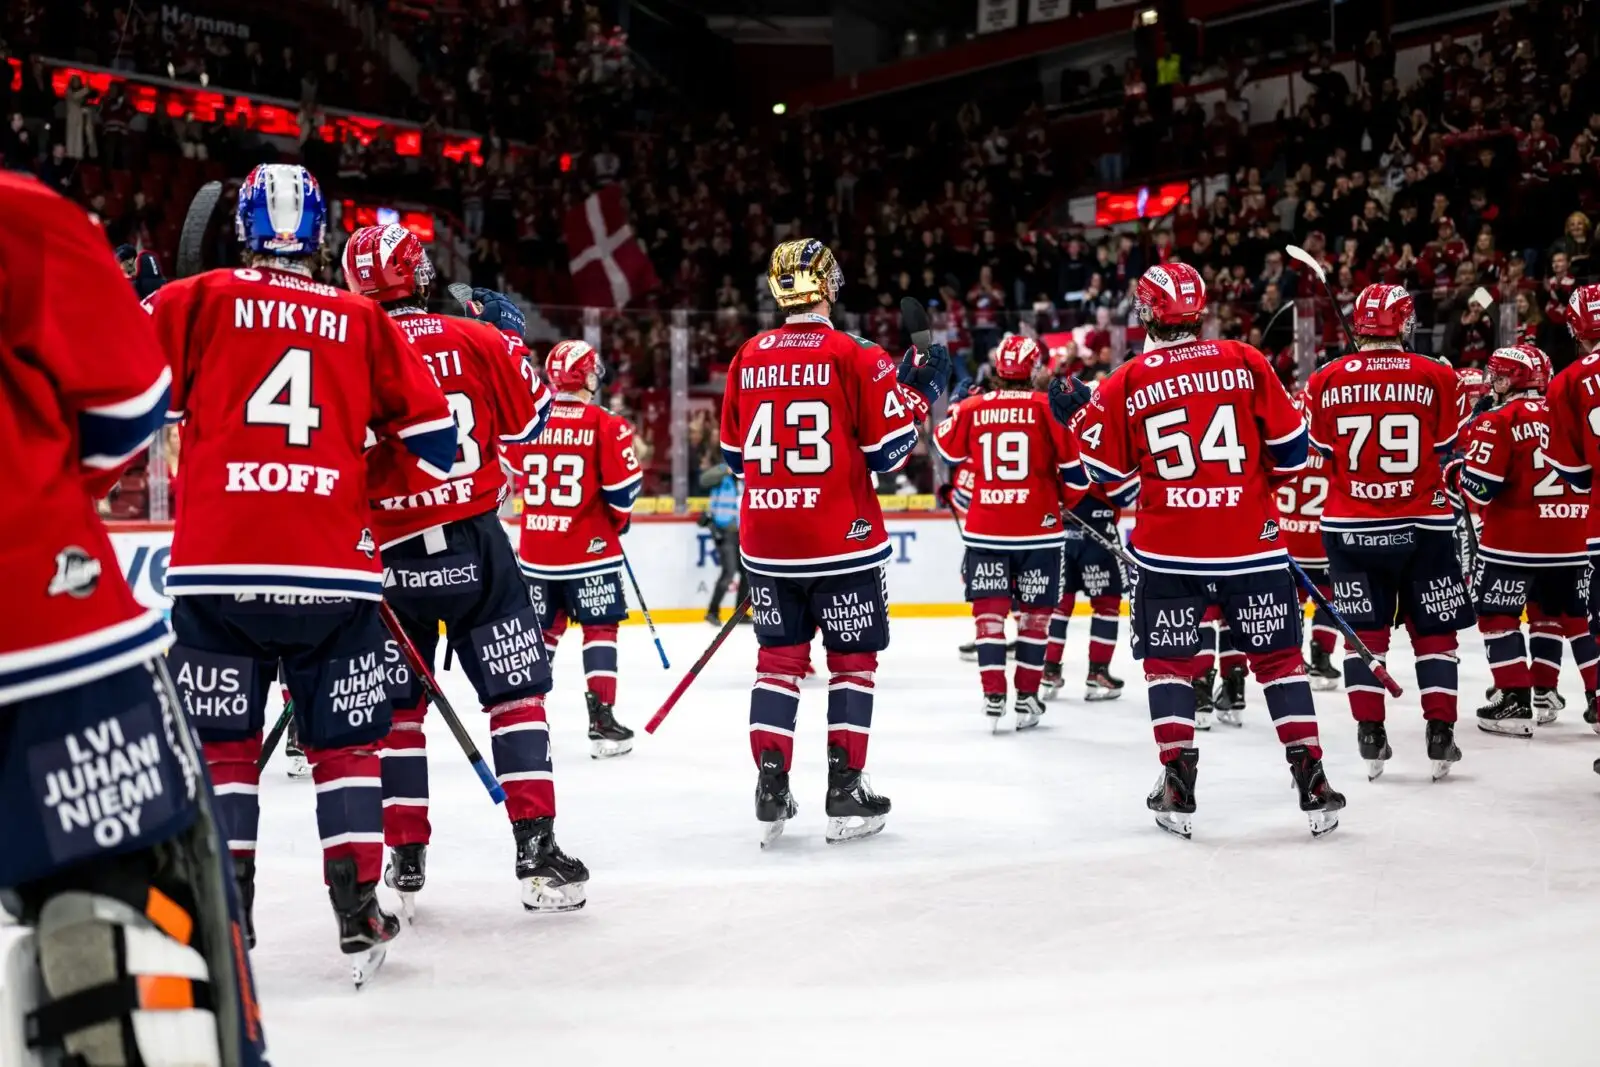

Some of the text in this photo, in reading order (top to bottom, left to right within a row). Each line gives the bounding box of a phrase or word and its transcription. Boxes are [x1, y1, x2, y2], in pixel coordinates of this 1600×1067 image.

[235, 298, 348, 343] NYKYRI
[401, 317, 442, 330] RKISH
[776, 340, 823, 348] AIRLINES
[782, 333, 825, 341] TURKISH
[1167, 344, 1217, 357] TURKISH
[1169, 348, 1219, 364] AIRLINES
[741, 363, 830, 389] MARLEAU
[246, 347, 320, 446] 4
[1126, 368, 1255, 417] SOMERVUORI
[1322, 383, 1434, 409] HARTIKAINEN
[973, 408, 1036, 426] LUNDELL
[743, 401, 833, 475] 43
[1144, 404, 1246, 480] 54
[1337, 414, 1420, 474] 79
[978, 431, 1029, 481] 19
[1464, 440, 1494, 464] 25
[225, 462, 339, 496] KOFF
[523, 454, 584, 507] 33
[381, 478, 474, 511] KOFF
[748, 487, 821, 509] KOFF
[980, 489, 1029, 504] KOFF
[1166, 486, 1243, 508] KOFF
[1350, 479, 1414, 500] KOFF
[1538, 504, 1589, 519] KOFF
[526, 513, 572, 533] KOFF
[846, 520, 873, 540] Liiga
[1279, 517, 1321, 533] KOFF
[1357, 531, 1414, 547] Taratest
[397, 563, 479, 588] Taratest
[975, 562, 1004, 577] AUS
[577, 583, 616, 598] JUHANI
[585, 575, 604, 587] LVI
[971, 577, 1008, 590] SÄHKÖ
[1334, 581, 1363, 598] AUS
[1430, 576, 1452, 590] LVI
[1491, 579, 1525, 594] AUS
[581, 594, 615, 608] NIEMI
[751, 587, 772, 606] US
[832, 592, 858, 606] LVI
[1022, 593, 1036, 603] OY
[1248, 592, 1274, 607] LVI
[1420, 582, 1464, 604] JUHANI
[1483, 590, 1526, 606] SÄHKÖ
[591, 606, 607, 616] OY
[822, 601, 874, 620] JUHANI
[1236, 603, 1288, 620] JUHANI
[1333, 598, 1372, 614] SÄHKÖ
[1425, 595, 1465, 614] NIEMI
[827, 615, 873, 631] NIEMI
[1155, 607, 1195, 628] AUS
[1439, 609, 1458, 621] OY
[492, 617, 522, 640] LVI
[1242, 617, 1284, 634] NIEMI
[482, 628, 537, 661] JUHANI
[840, 630, 861, 642] OY
[1251, 633, 1273, 646] OY
[349, 652, 376, 676] LVI
[489, 645, 540, 675] NIEMI
[177, 661, 240, 693] AUS
[330, 664, 385, 697] JUHANI
[508, 666, 532, 685] OY
[184, 690, 248, 716] ÄHKÖ
[333, 683, 386, 712] NIEMI
[348, 706, 374, 727] OY
[65, 717, 125, 764] LVI
[44, 733, 160, 807] JUHANI
[57, 766, 163, 833] NIEMI
[93, 805, 141, 848] OY
